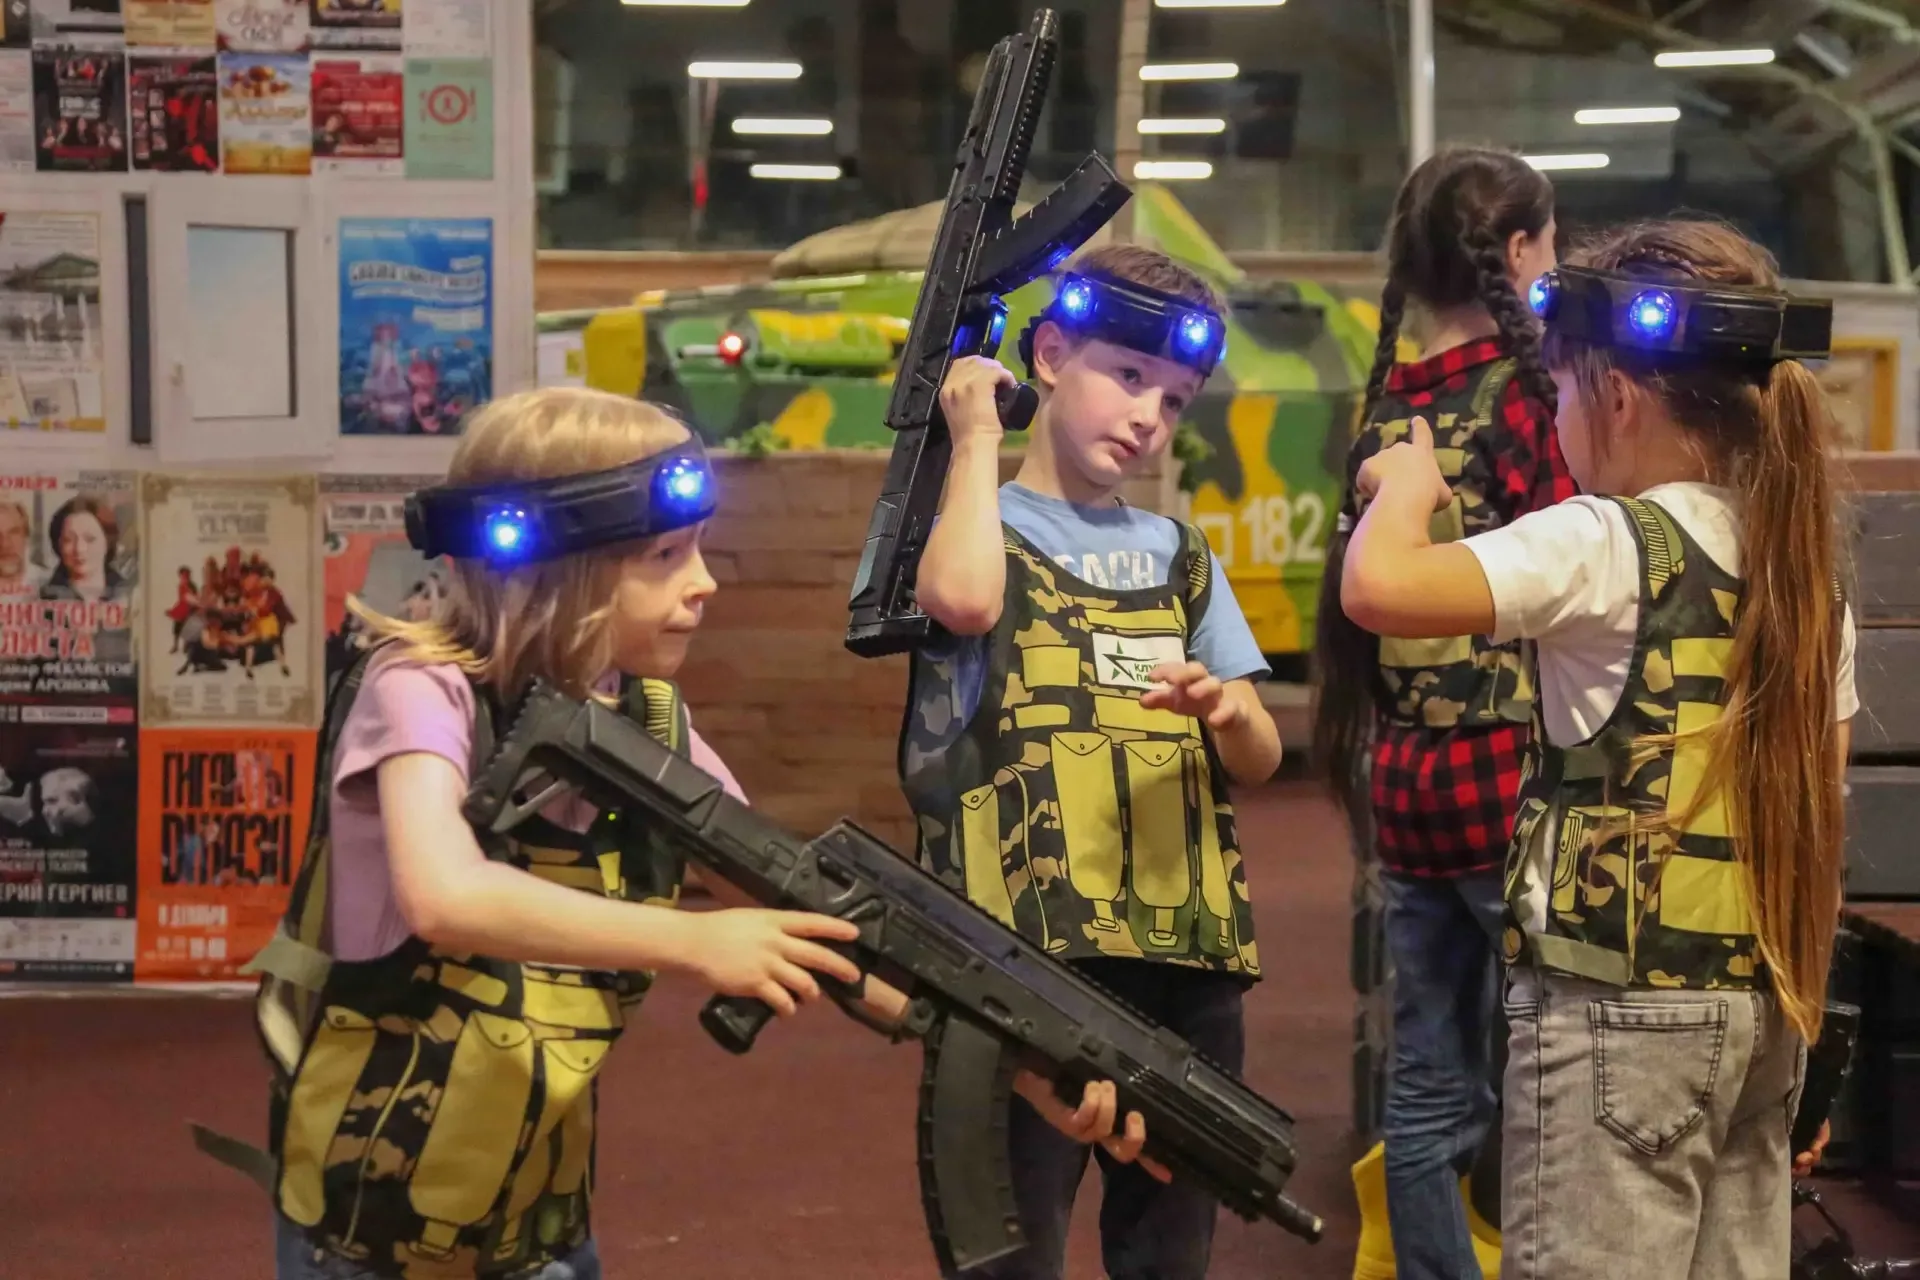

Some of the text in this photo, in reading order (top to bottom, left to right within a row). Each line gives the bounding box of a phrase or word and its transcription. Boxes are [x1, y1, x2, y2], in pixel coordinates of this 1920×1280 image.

[0, 476, 58, 490] ОЯБРЯ
[1241, 493, 1326, 566] 182
[1, 630, 94, 658] ЛИСТА
[1134, 663, 1160, 673] КЛУ
[48, 883, 128, 903] ГЕРГИЕВ
